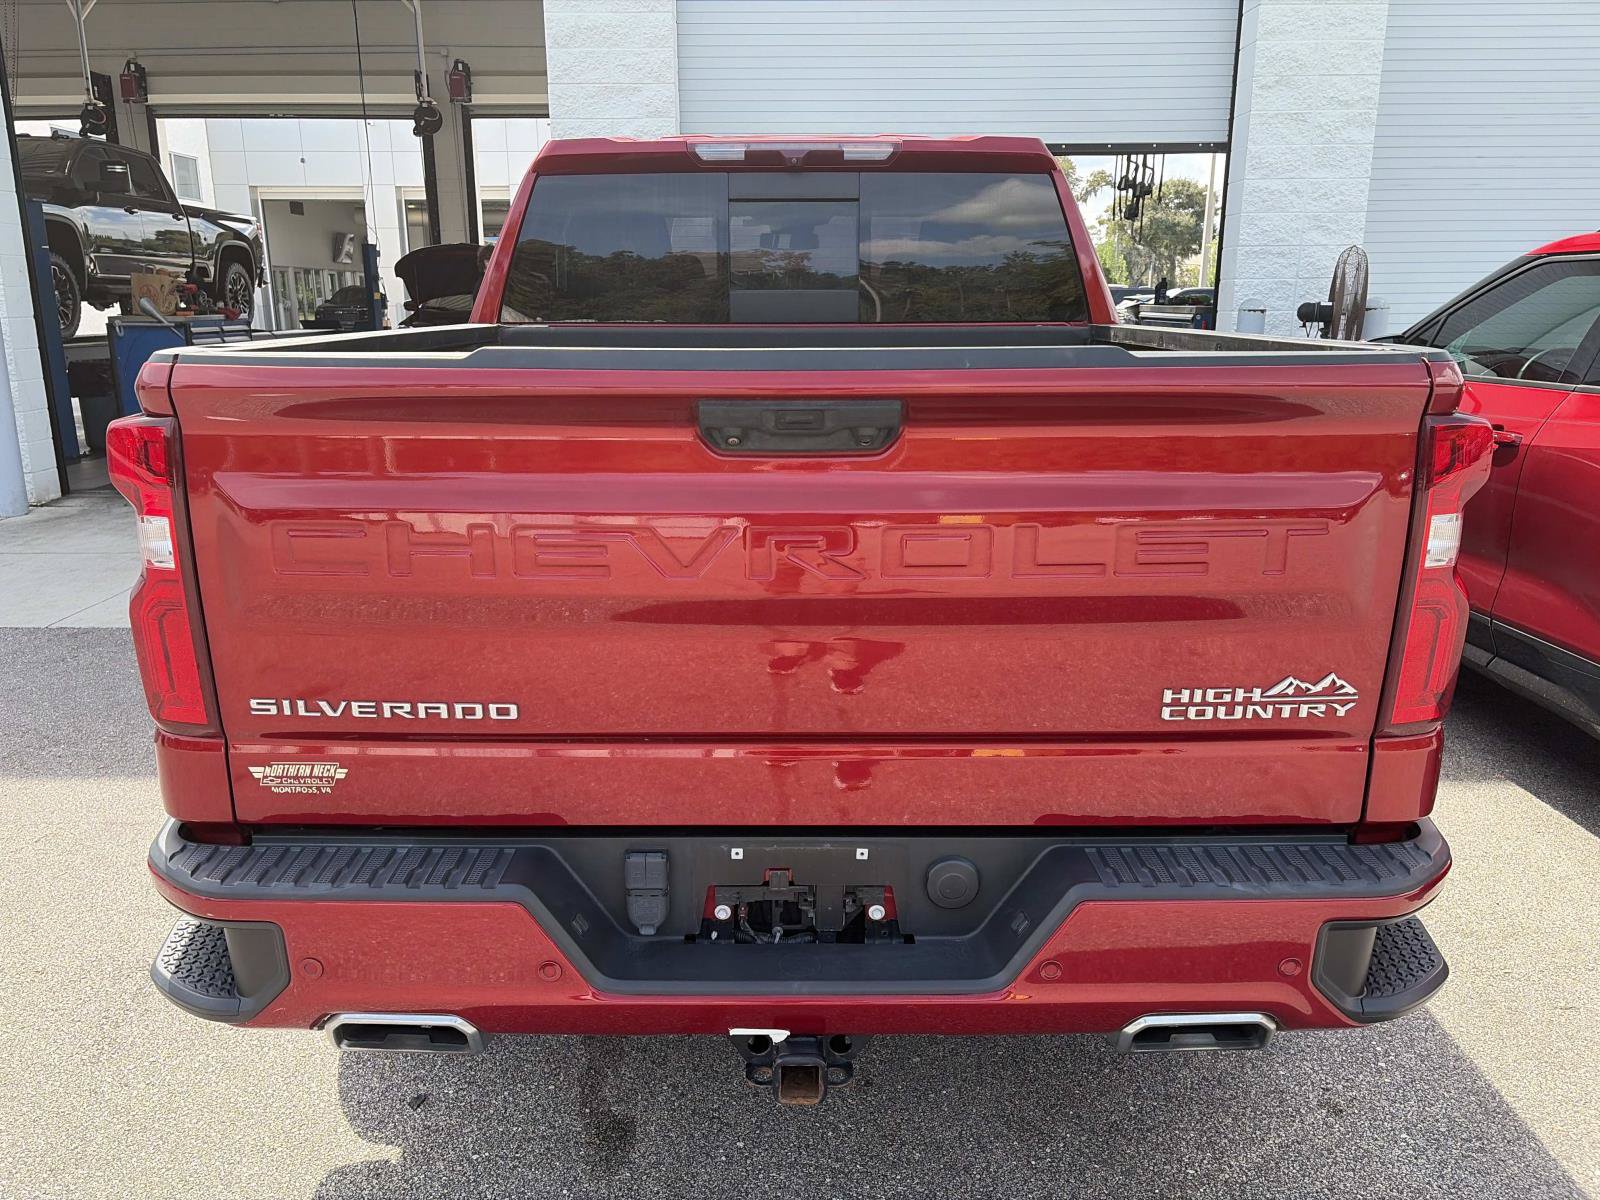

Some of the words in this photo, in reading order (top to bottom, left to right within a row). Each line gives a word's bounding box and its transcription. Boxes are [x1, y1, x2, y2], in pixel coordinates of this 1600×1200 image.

[271, 520, 1330, 582] CHEVROLET
[1162, 687, 1262, 704] HIGH
[249, 698, 519, 721] SILVERADO
[1161, 702, 1357, 721] COUNTRY
[312, 764, 337, 777] NECK
[321, 786, 332, 794] VA
